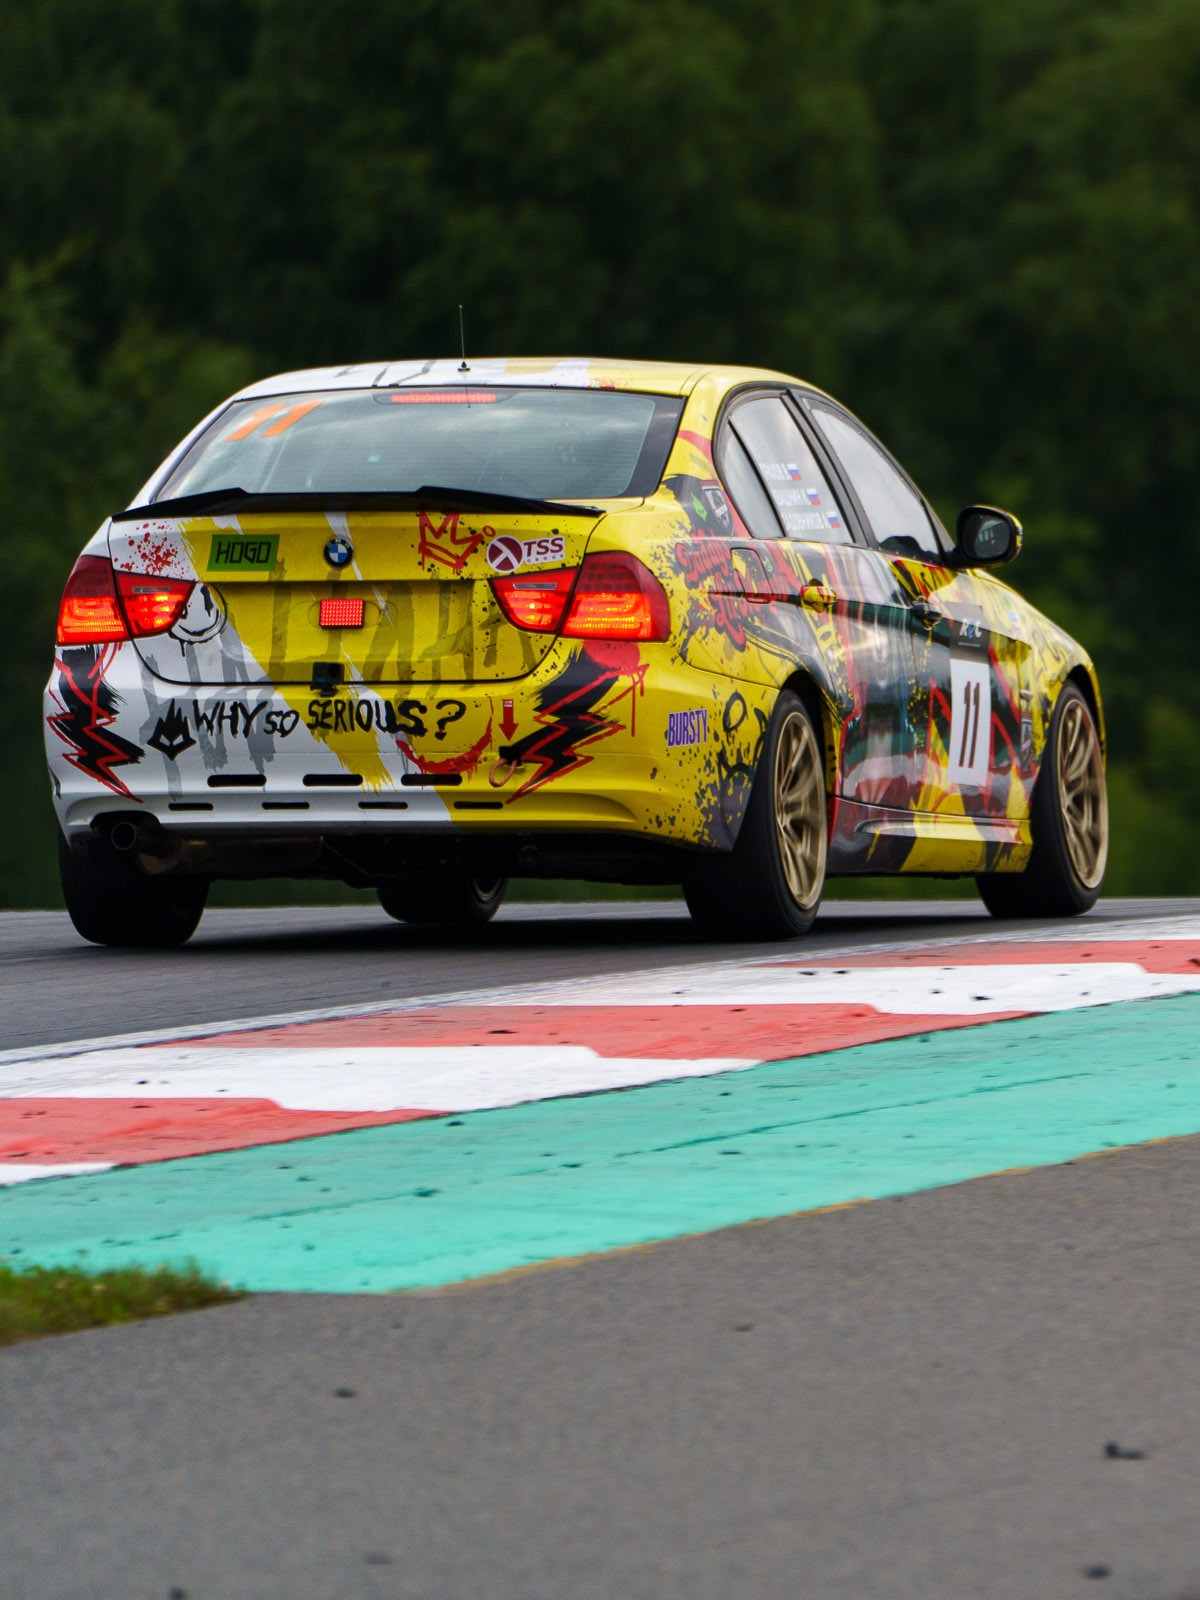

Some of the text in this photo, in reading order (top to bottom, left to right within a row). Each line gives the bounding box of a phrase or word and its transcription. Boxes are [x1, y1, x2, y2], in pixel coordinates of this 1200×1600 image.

[215, 541, 272, 564] HOGO
[523, 537, 564, 557] TSS
[193, 699, 268, 738] WHY
[667, 708, 708, 747] BURSTY
[958, 681, 980, 769] 11
